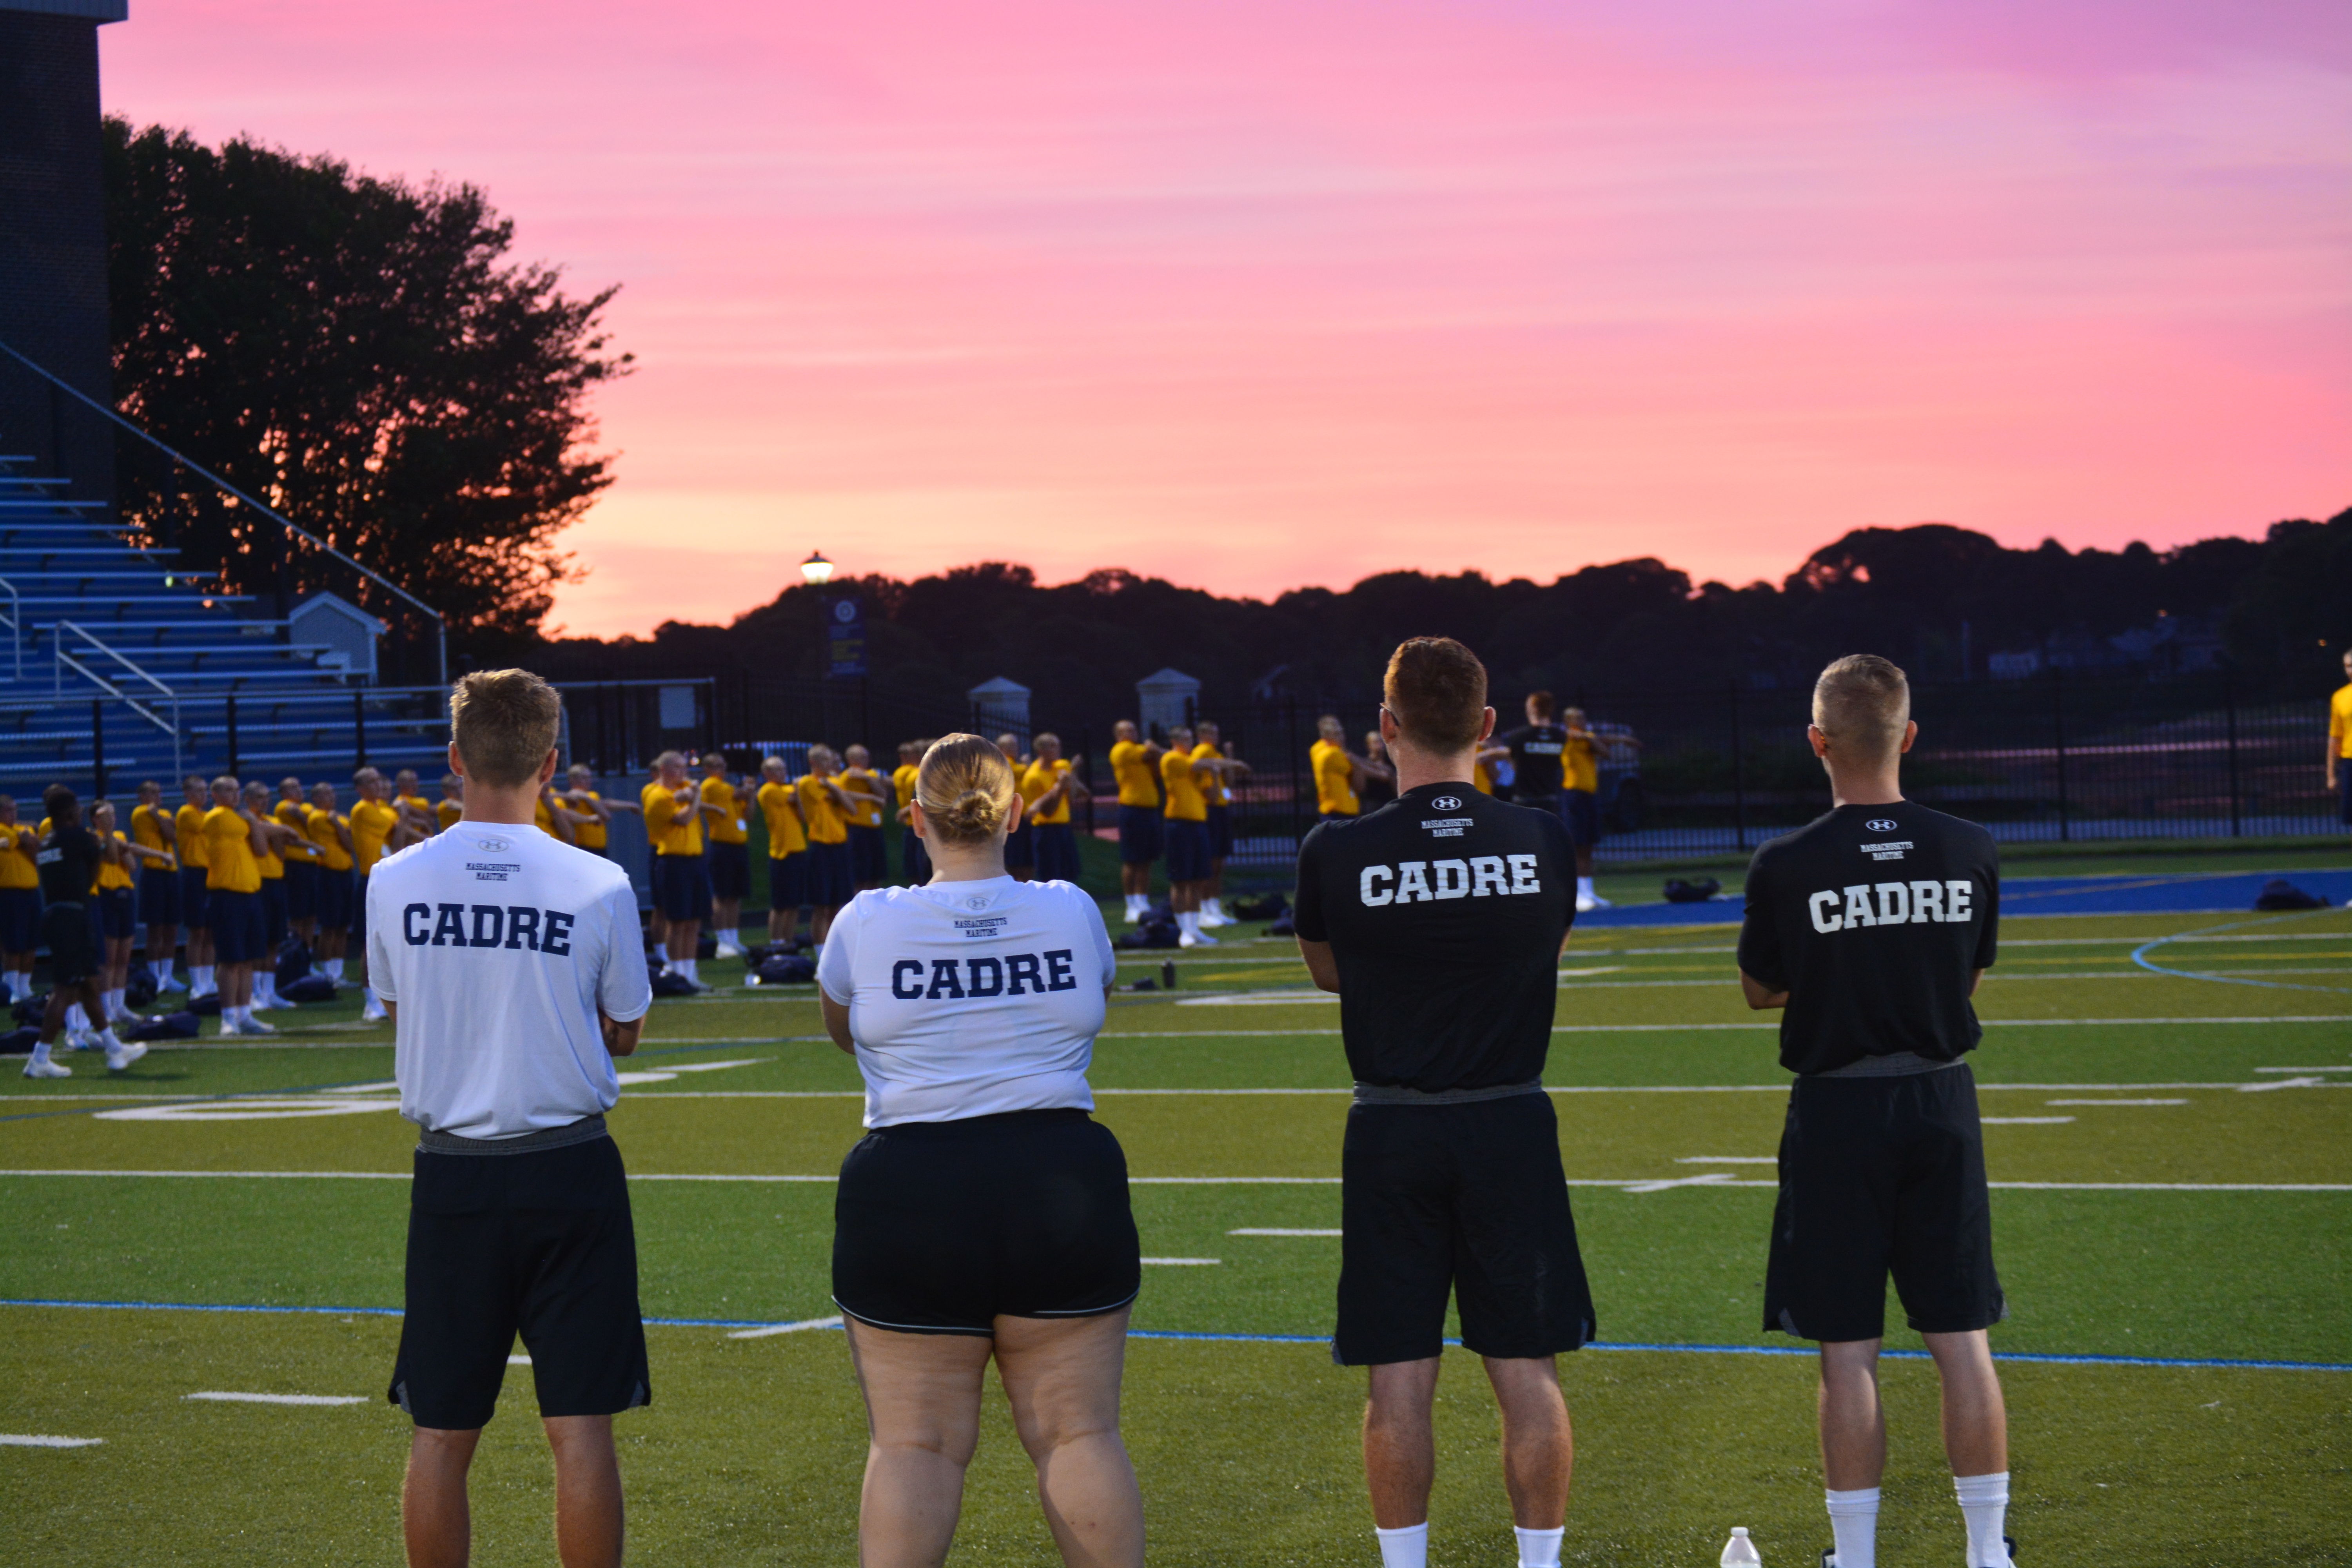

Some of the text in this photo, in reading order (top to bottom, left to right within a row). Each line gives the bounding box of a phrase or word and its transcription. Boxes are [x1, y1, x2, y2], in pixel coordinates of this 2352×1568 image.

[1421, 818, 1474, 829] MASSACHUSETTS
[1432, 828, 1464, 837] MARITIME
[1860, 841, 1914, 852] MASSACHUSETTS
[1872, 851, 1904, 860] MARITIME
[466, 863, 520, 872] MASSACHUSETTS
[476, 872, 508, 881] MARITIME
[1361, 855, 1540, 906] CADRE
[1809, 880, 1972, 933] CADRE
[954, 917, 1007, 928] MASSACHUSETTS
[404, 903, 574, 956] CADRE
[965, 928, 998, 937] MARITIME
[892, 949, 1076, 999] CADRE
